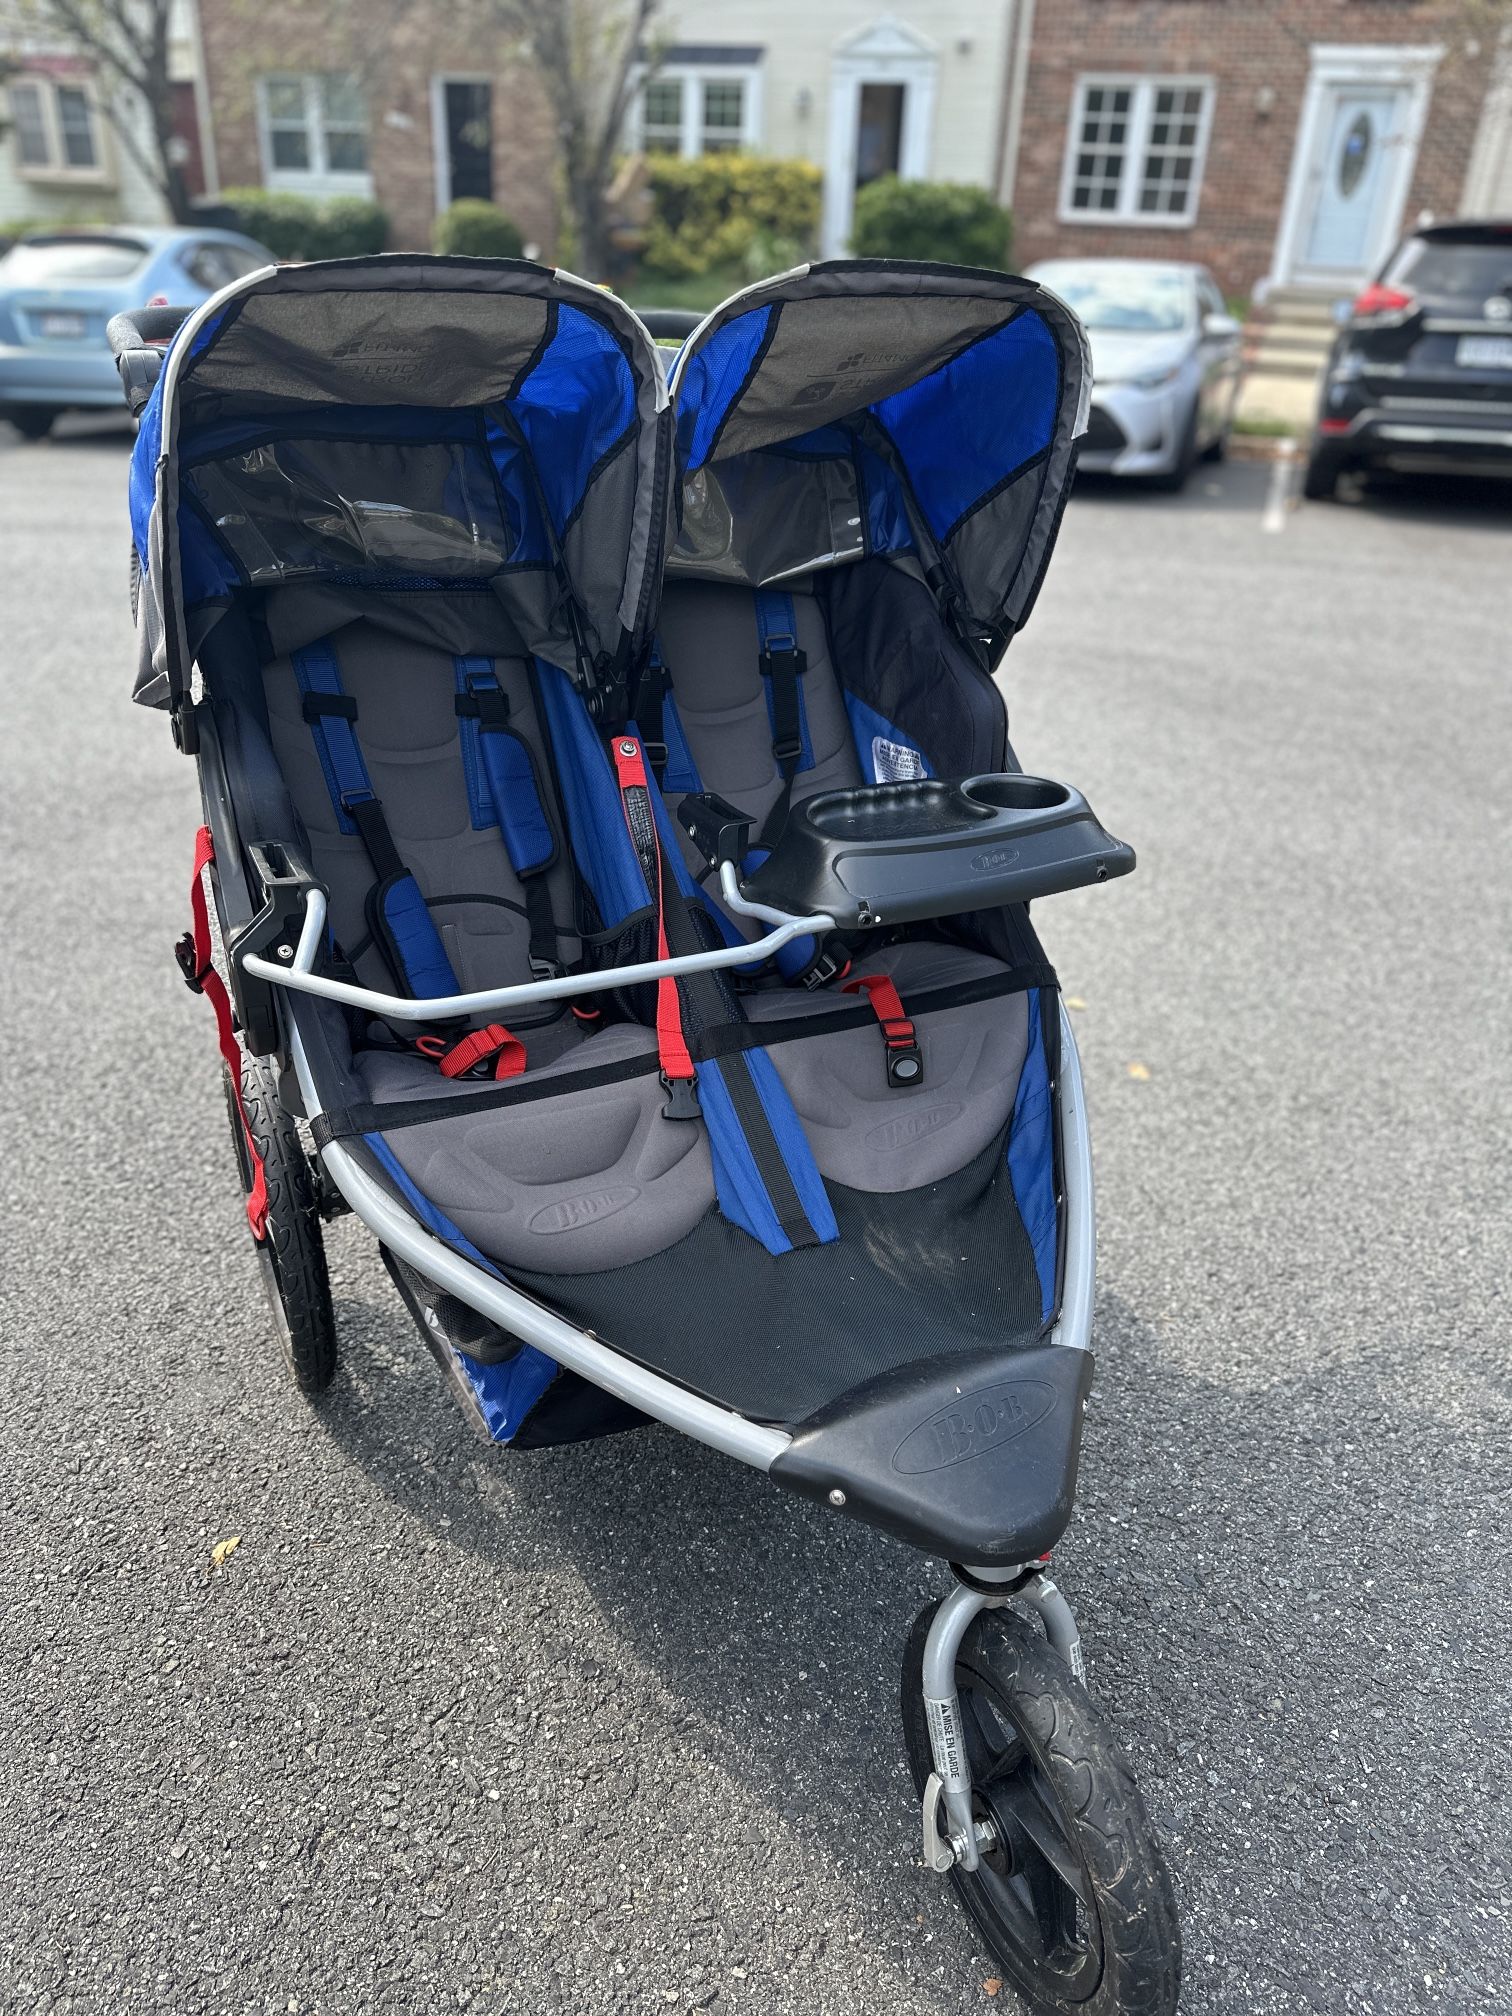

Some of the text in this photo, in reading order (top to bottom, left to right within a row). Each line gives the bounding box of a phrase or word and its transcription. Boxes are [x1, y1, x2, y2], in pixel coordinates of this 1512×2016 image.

[942, 1714, 954, 1736] MISE
[945, 1737, 955, 1749] EN
[947, 1750, 960, 1779] GARDE
